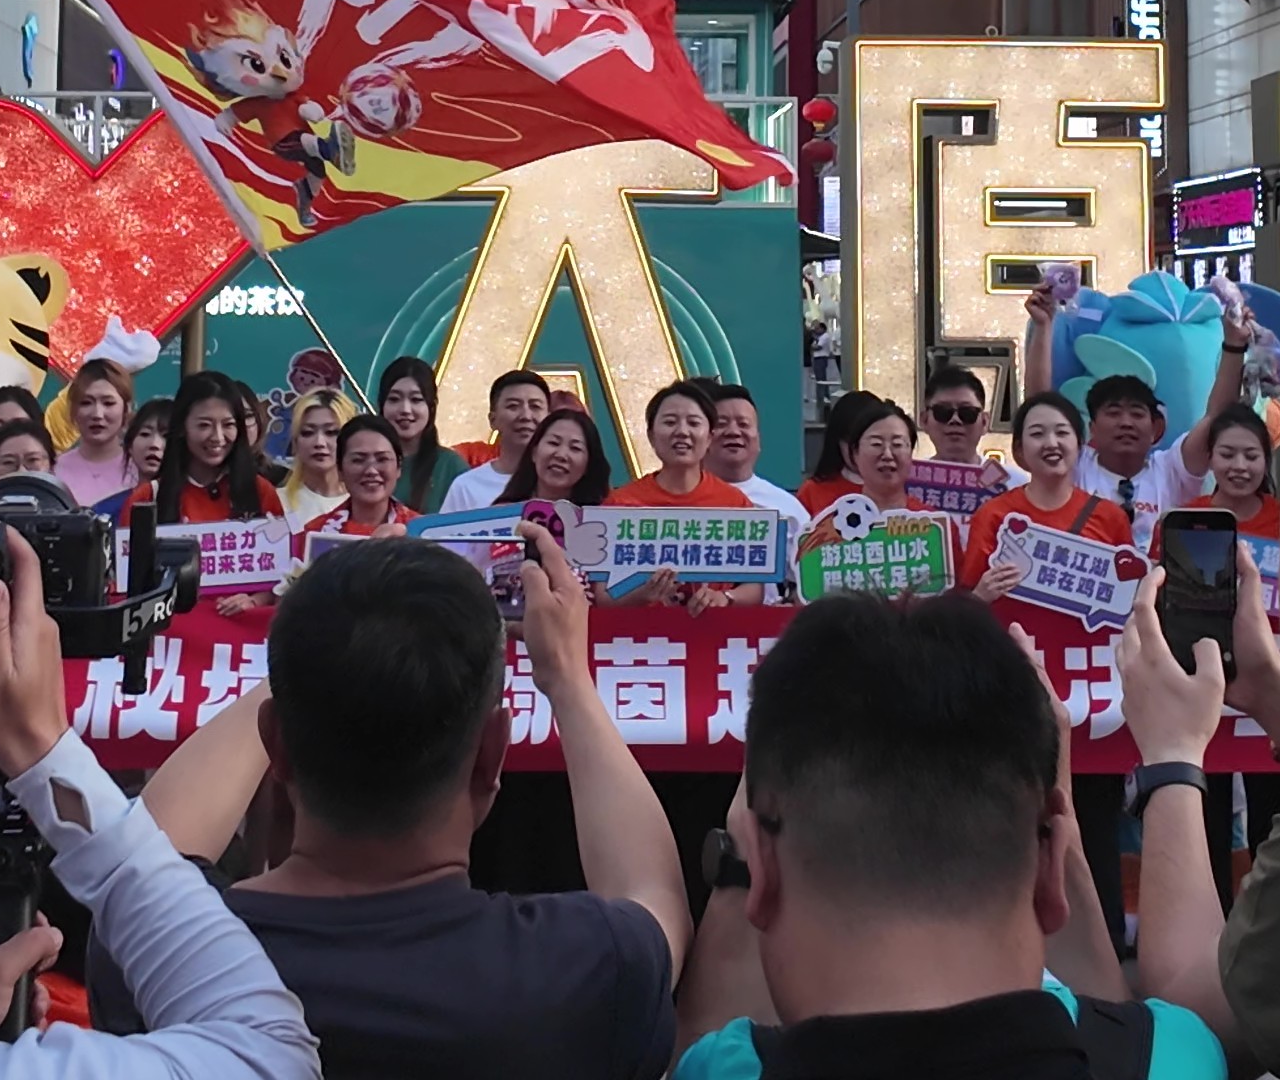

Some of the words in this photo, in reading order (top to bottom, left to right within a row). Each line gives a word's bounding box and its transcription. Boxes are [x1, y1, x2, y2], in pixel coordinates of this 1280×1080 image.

[616, 518, 770, 542] 北国风光无限好
[614, 544, 768, 567] 醉美风情在鸡西
[821, 537, 930, 567] 游鸡西山水
[1032, 539, 1110, 577] 最美江湖
[1036, 564, 1116, 605] 醉在鸡西
